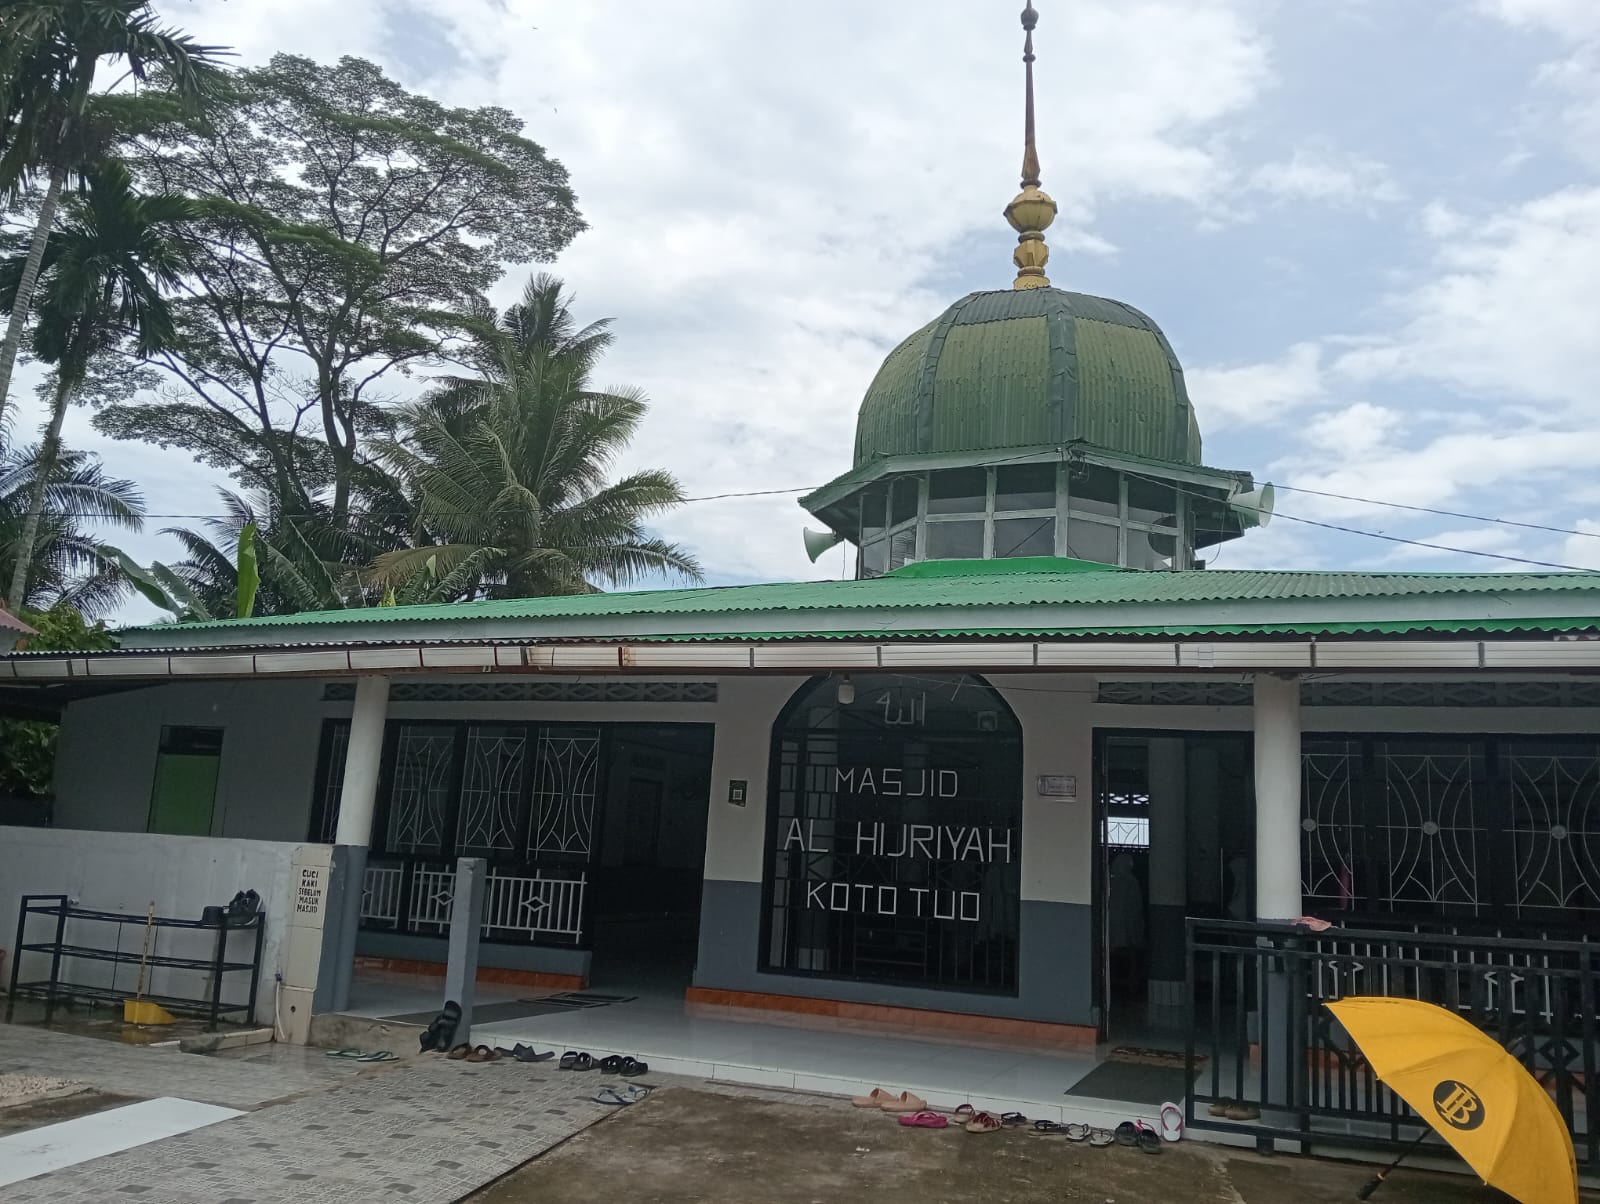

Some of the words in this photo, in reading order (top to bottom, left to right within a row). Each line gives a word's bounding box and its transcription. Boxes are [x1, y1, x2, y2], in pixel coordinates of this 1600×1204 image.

[835, 767, 958, 798] MASJID
[784, 818, 829, 852] AL
[856, 821, 1011, 863] HIJRIYAH
[302, 869, 319, 879] CUCI
[301, 879, 318, 887] KAKI
[299, 896, 319, 905] MASUK
[807, 881, 897, 915] KOTO
[909, 887, 980, 922] TUO
[296, 904, 318, 913] MASJID
